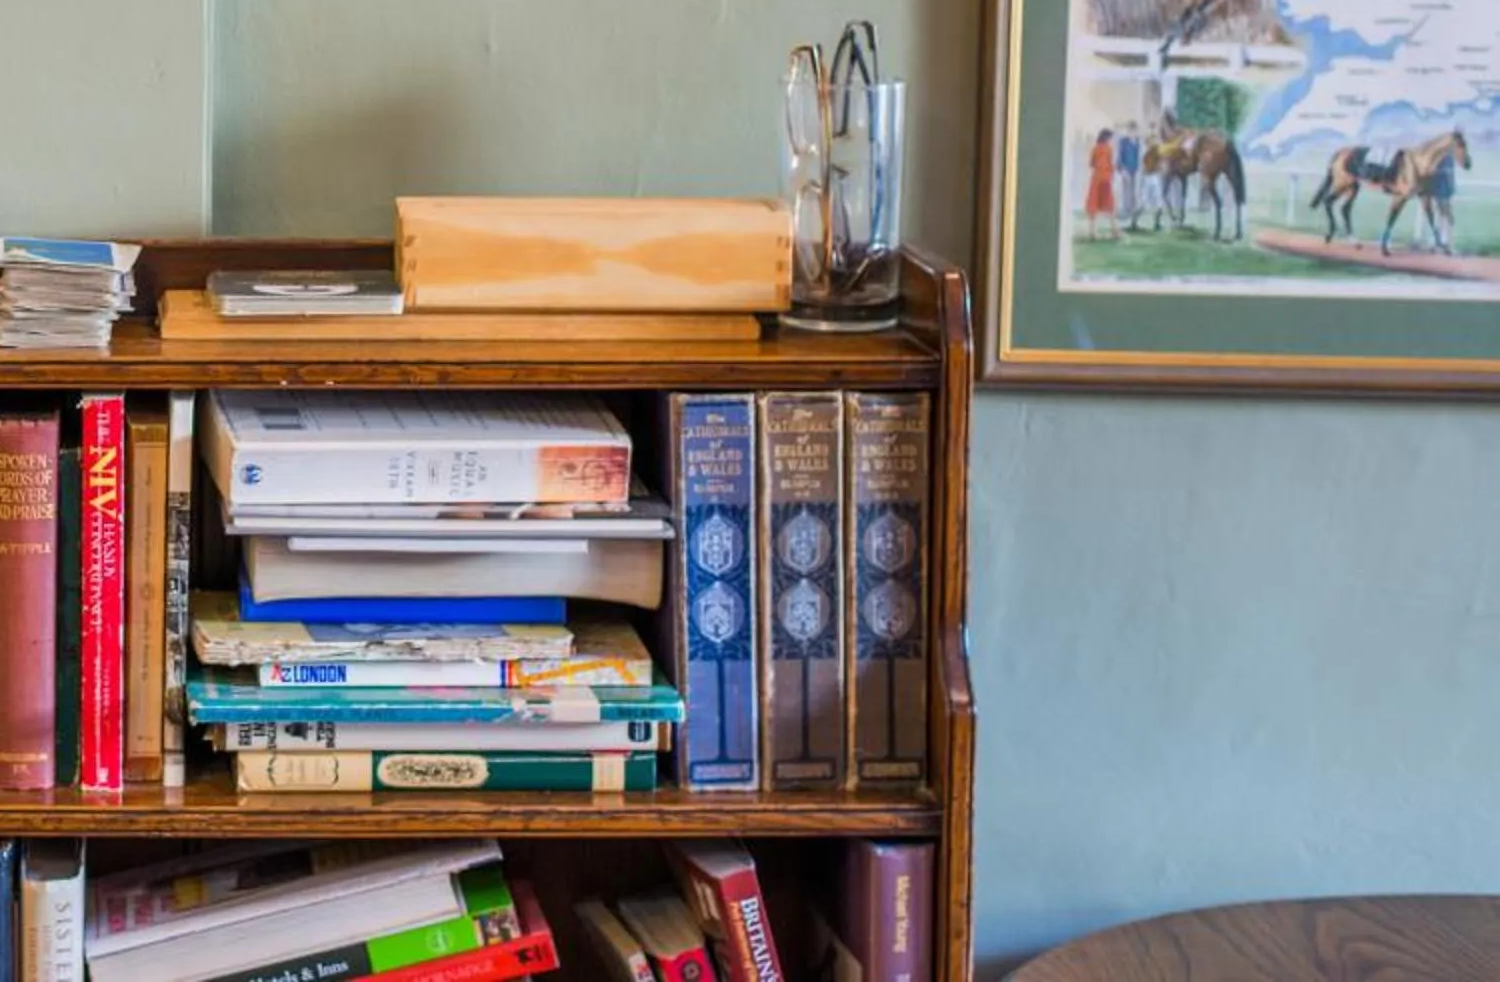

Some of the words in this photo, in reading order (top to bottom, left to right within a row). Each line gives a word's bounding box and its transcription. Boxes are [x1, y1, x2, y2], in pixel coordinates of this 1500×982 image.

[89, 444, 117, 520] NIV
[12, 503, 55, 519] PRAISE
[293, 665, 347, 683] LONDON
[301, 966, 314, 980] &
[318, 960, 349, 977] Inns
